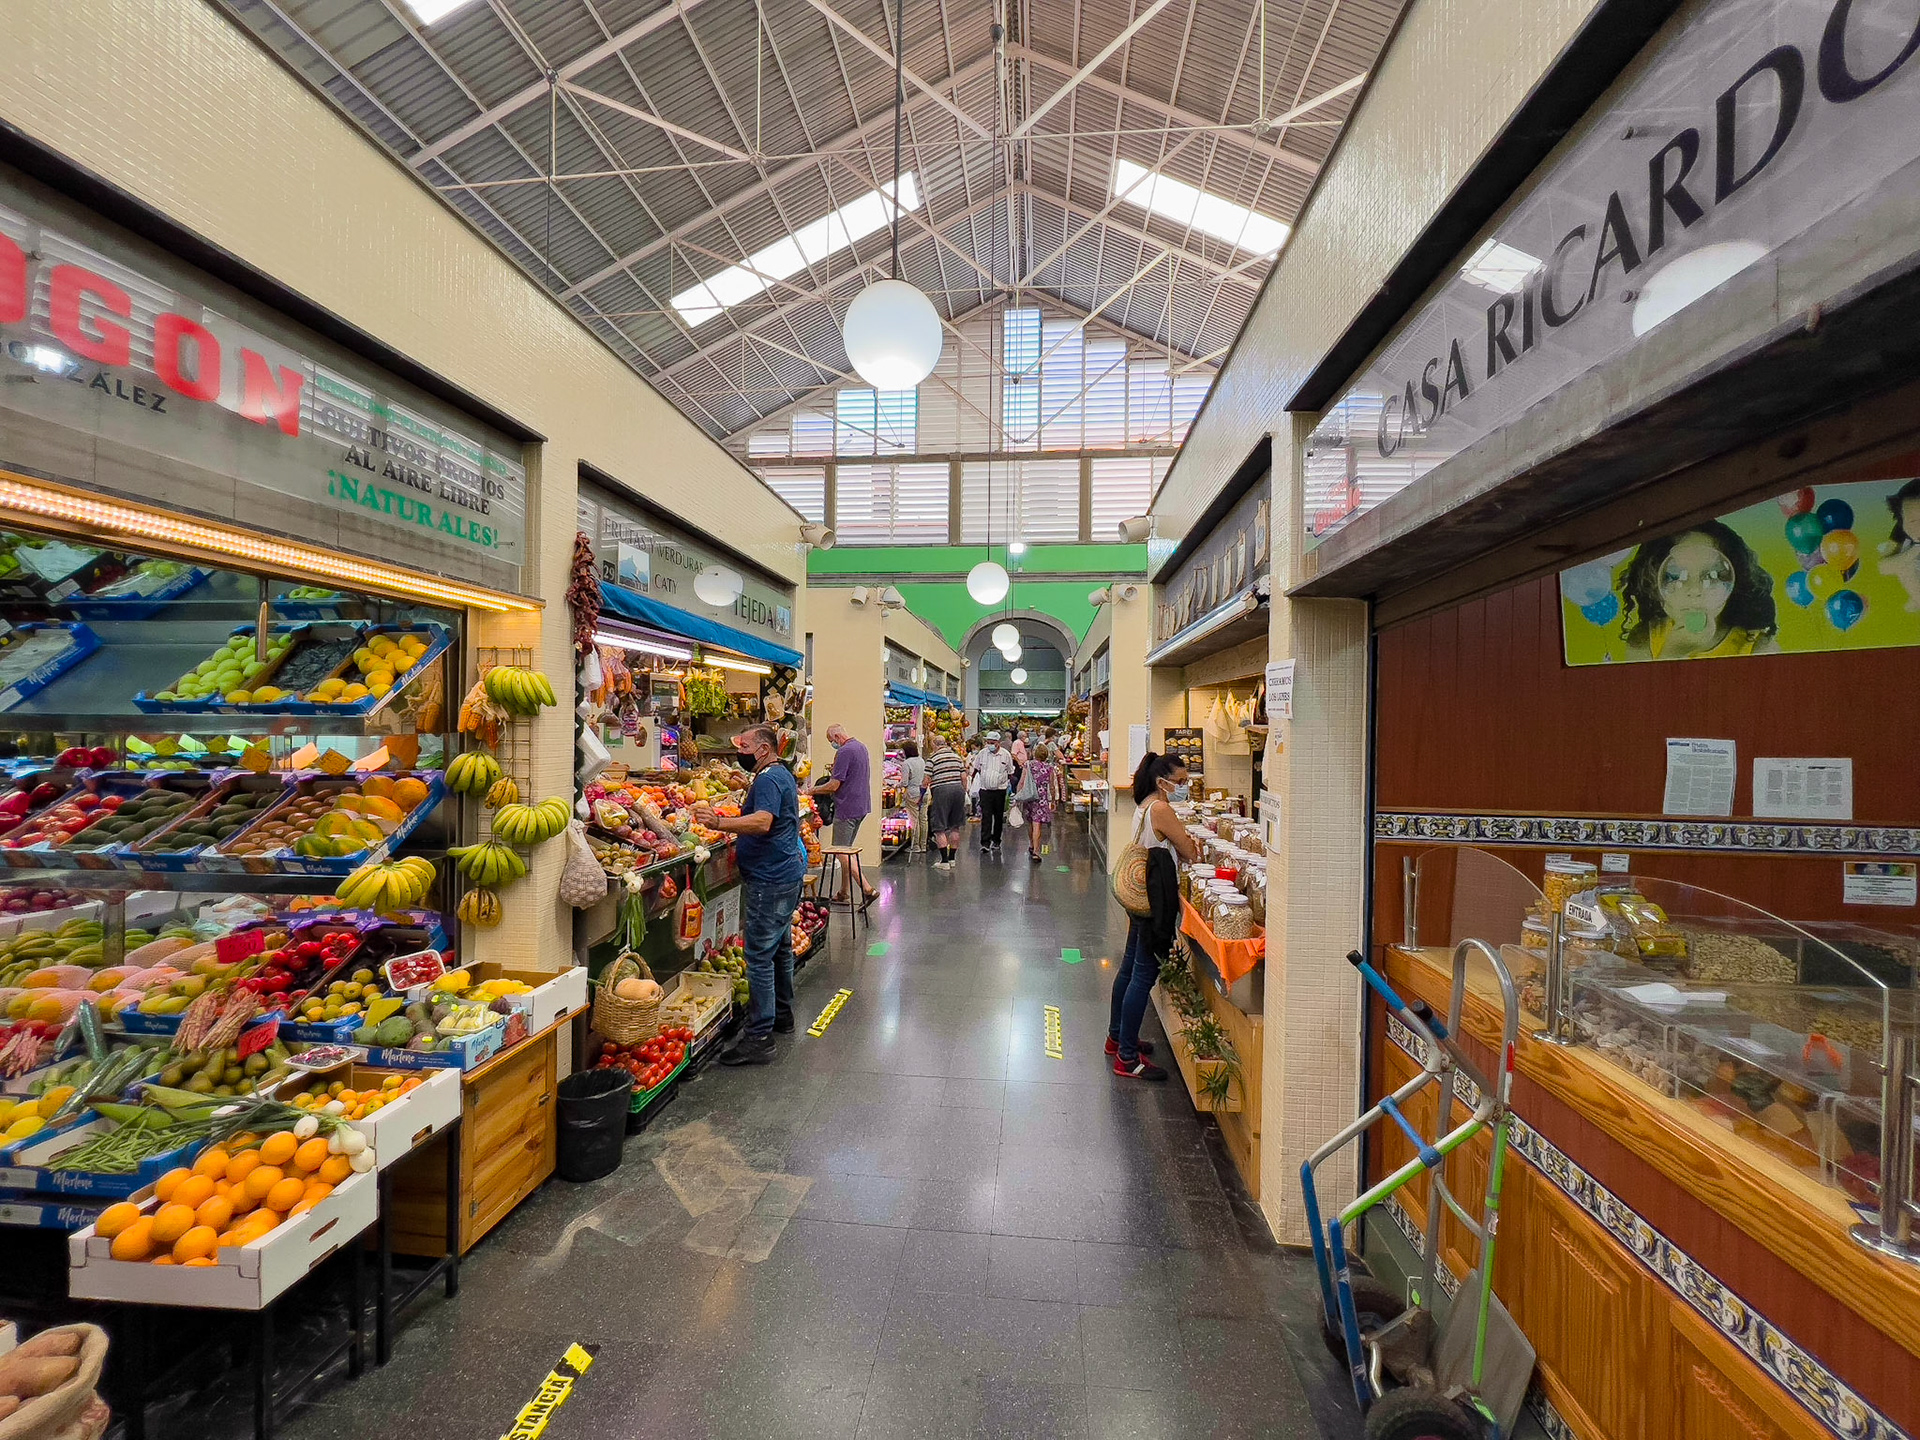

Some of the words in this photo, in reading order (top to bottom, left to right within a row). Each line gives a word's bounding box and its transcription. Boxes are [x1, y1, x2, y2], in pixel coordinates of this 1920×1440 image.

[1377, 338, 1470, 458] CASA
[321, 406, 427, 468] CULTIVOS
[434, 454, 505, 501] PROPIOS
[344, 444, 376, 472] AL
[382, 459, 432, 494] AIRE
[439, 481, 491, 516] LIBRE
[327, 469, 499, 550] ¡NATURALES!
[604, 518, 647, 550] FRUTAS
[658, 547, 704, 576] VERDURAS
[603, 566, 614, 580] 29
[654, 573, 679, 595] CATY
[733, 591, 776, 630] TEJEDA
[1568, 903, 1593, 924] ENTRADA
[381, 1048, 416, 1066] Marlene
[52, 1171, 94, 1192] Marlene
